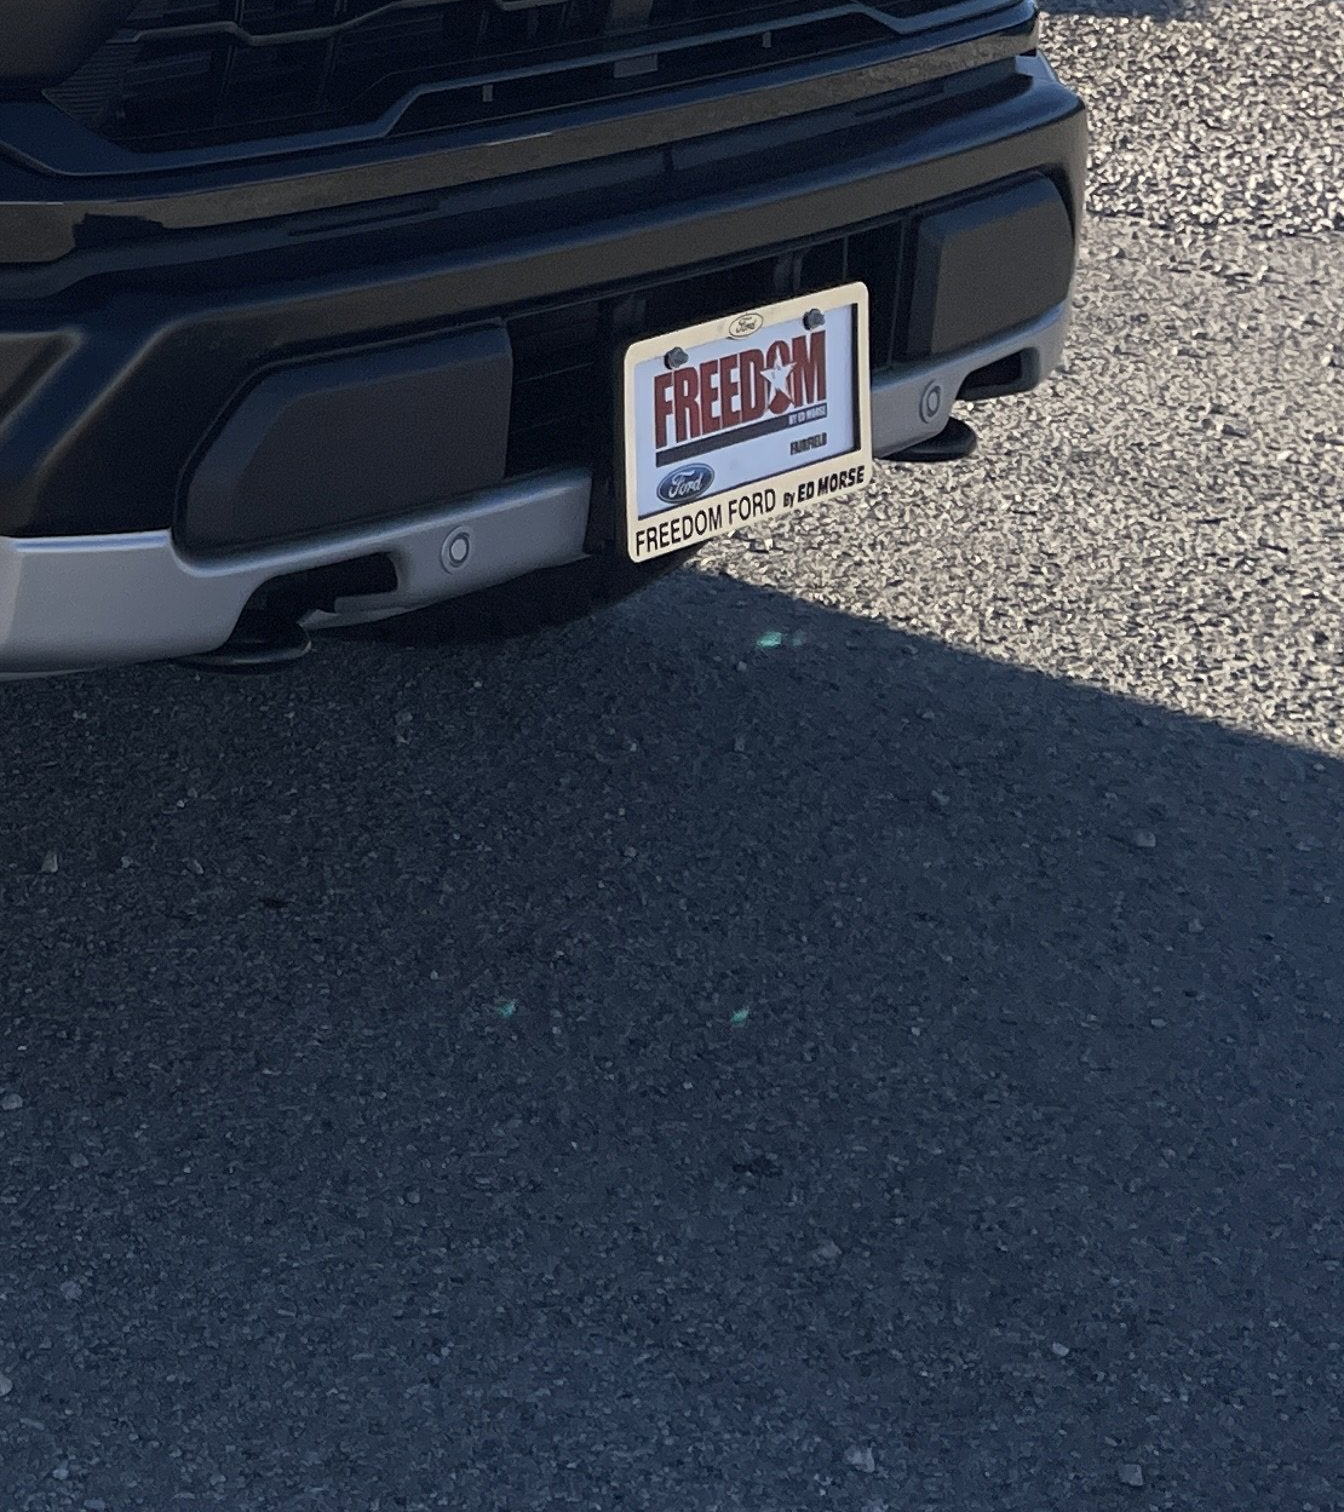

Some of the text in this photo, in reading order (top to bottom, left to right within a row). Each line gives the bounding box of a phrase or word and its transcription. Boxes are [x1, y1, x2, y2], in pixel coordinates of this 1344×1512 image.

[654, 330, 827, 449] FREEDOM
[635, 503, 723, 557] FREEDOM
[728, 488, 776, 526] FORD
[797, 482, 814, 502] ED
[816, 465, 866, 498] MORSE
[667, 474, 703, 499] Ford
